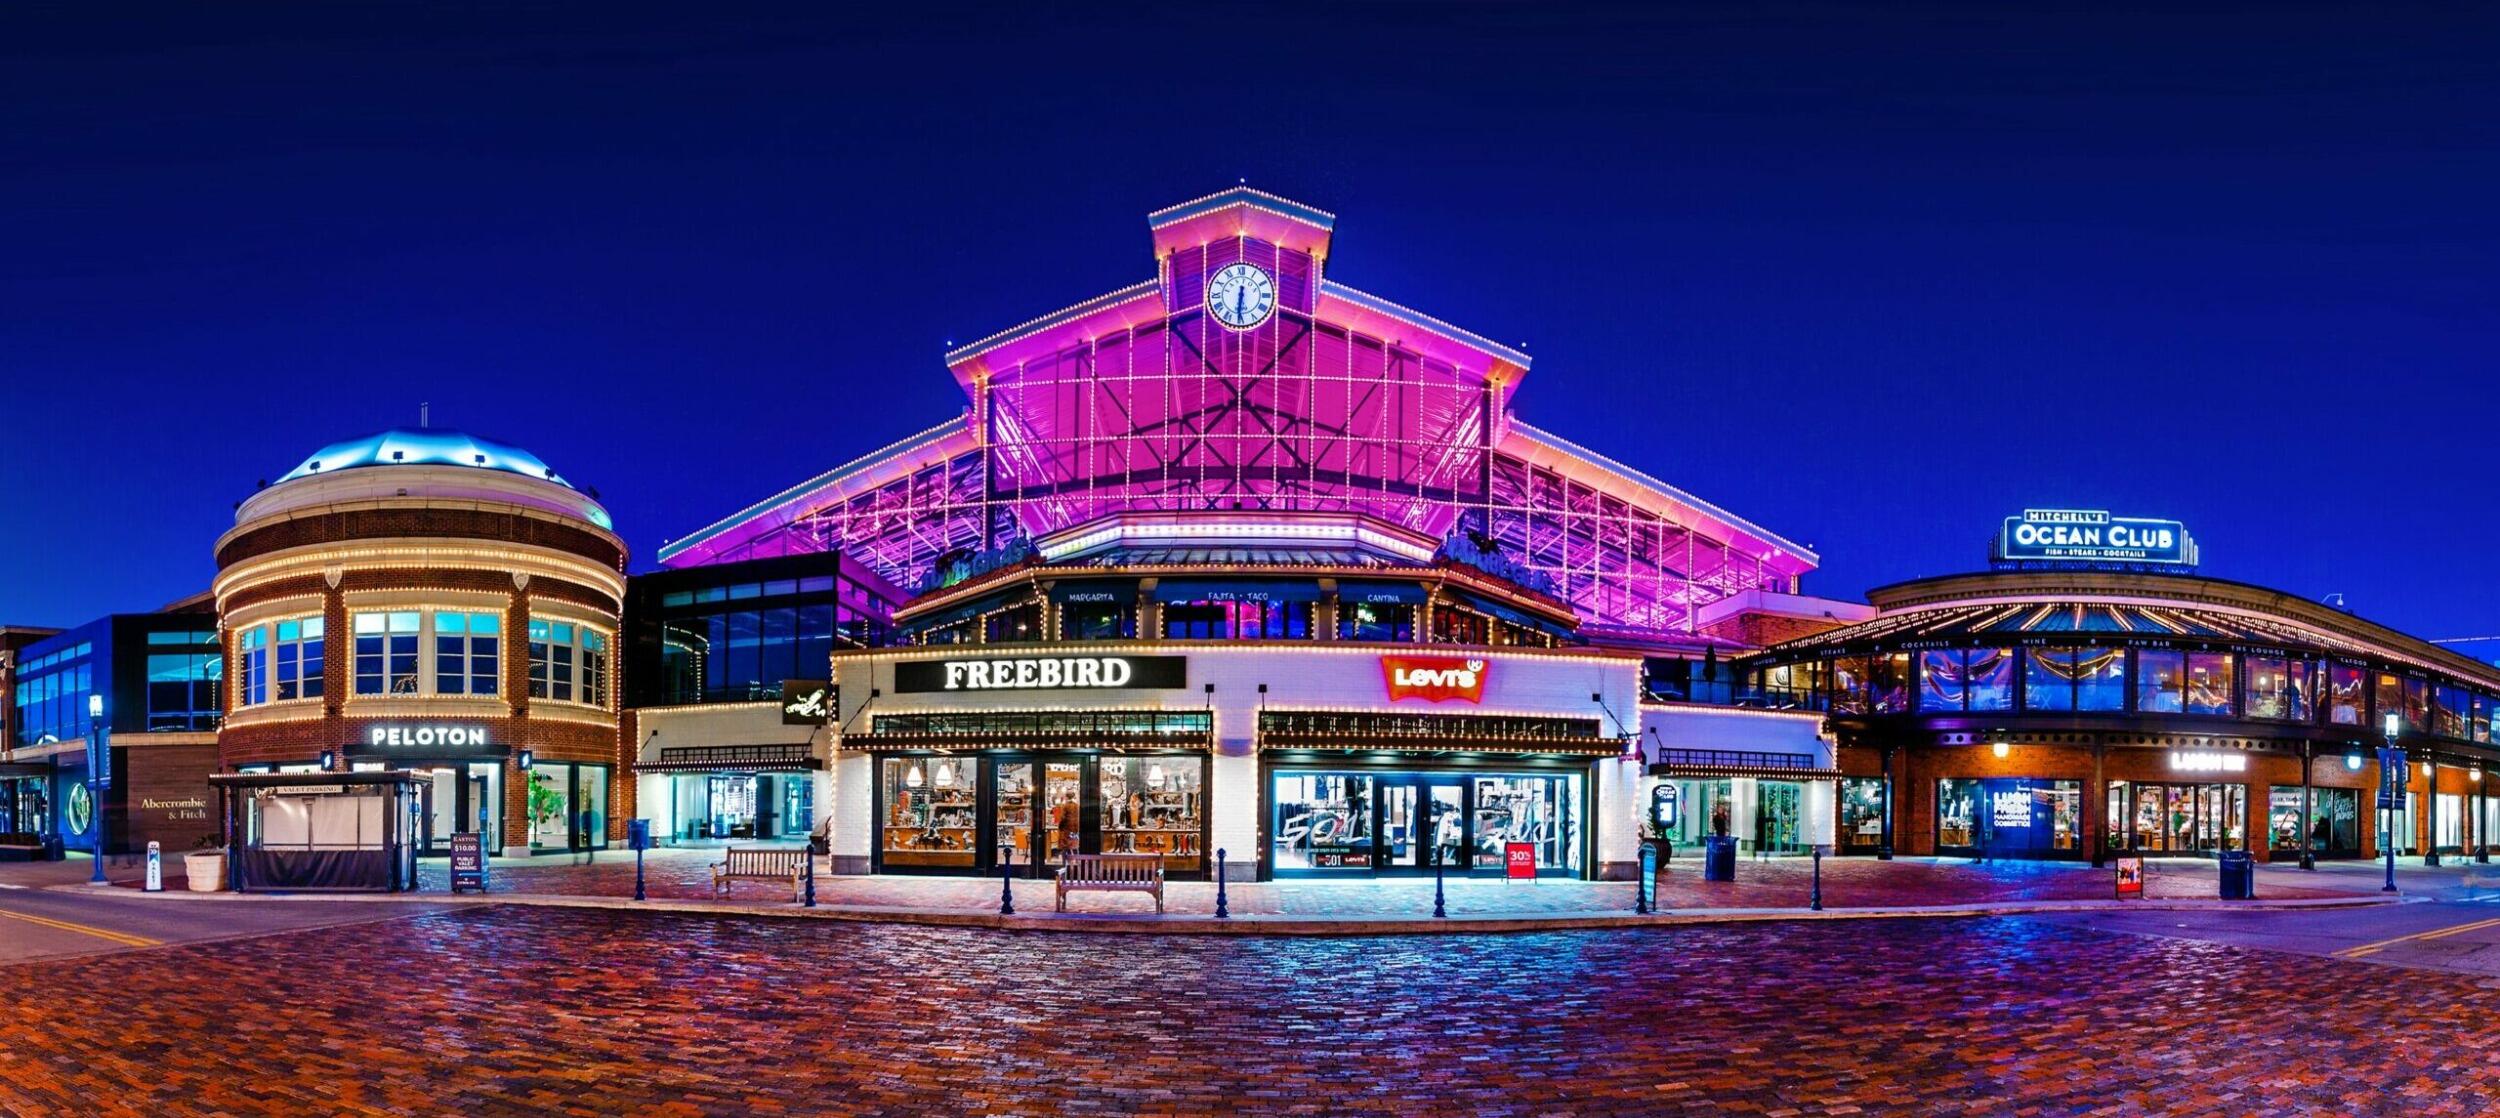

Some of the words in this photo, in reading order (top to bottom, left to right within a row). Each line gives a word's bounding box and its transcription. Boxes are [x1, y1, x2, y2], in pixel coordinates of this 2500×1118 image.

[2029, 512, 2103, 522] MITCHELL'S
[2016, 524, 2100, 545] OCEAN
[2108, 525, 2172, 548] CLUB
[2103, 549, 2146, 557] COCKTAILS
[1069, 593, 1114, 601] MARGARITA
[1208, 592, 1235, 600] FAJITA
[1247, 592, 1268, 600] TACO
[1367, 594, 1400, 602] CANTINA
[1901, 640, 1949, 649] COCKTAILS
[944, 658, 1131, 689] FREEBIRD
[371, 727, 485, 746] PELOTON
[141, 798, 207, 809] Abercrombie
[169, 812, 176, 820] &
[180, 810, 206, 819] Fitch
